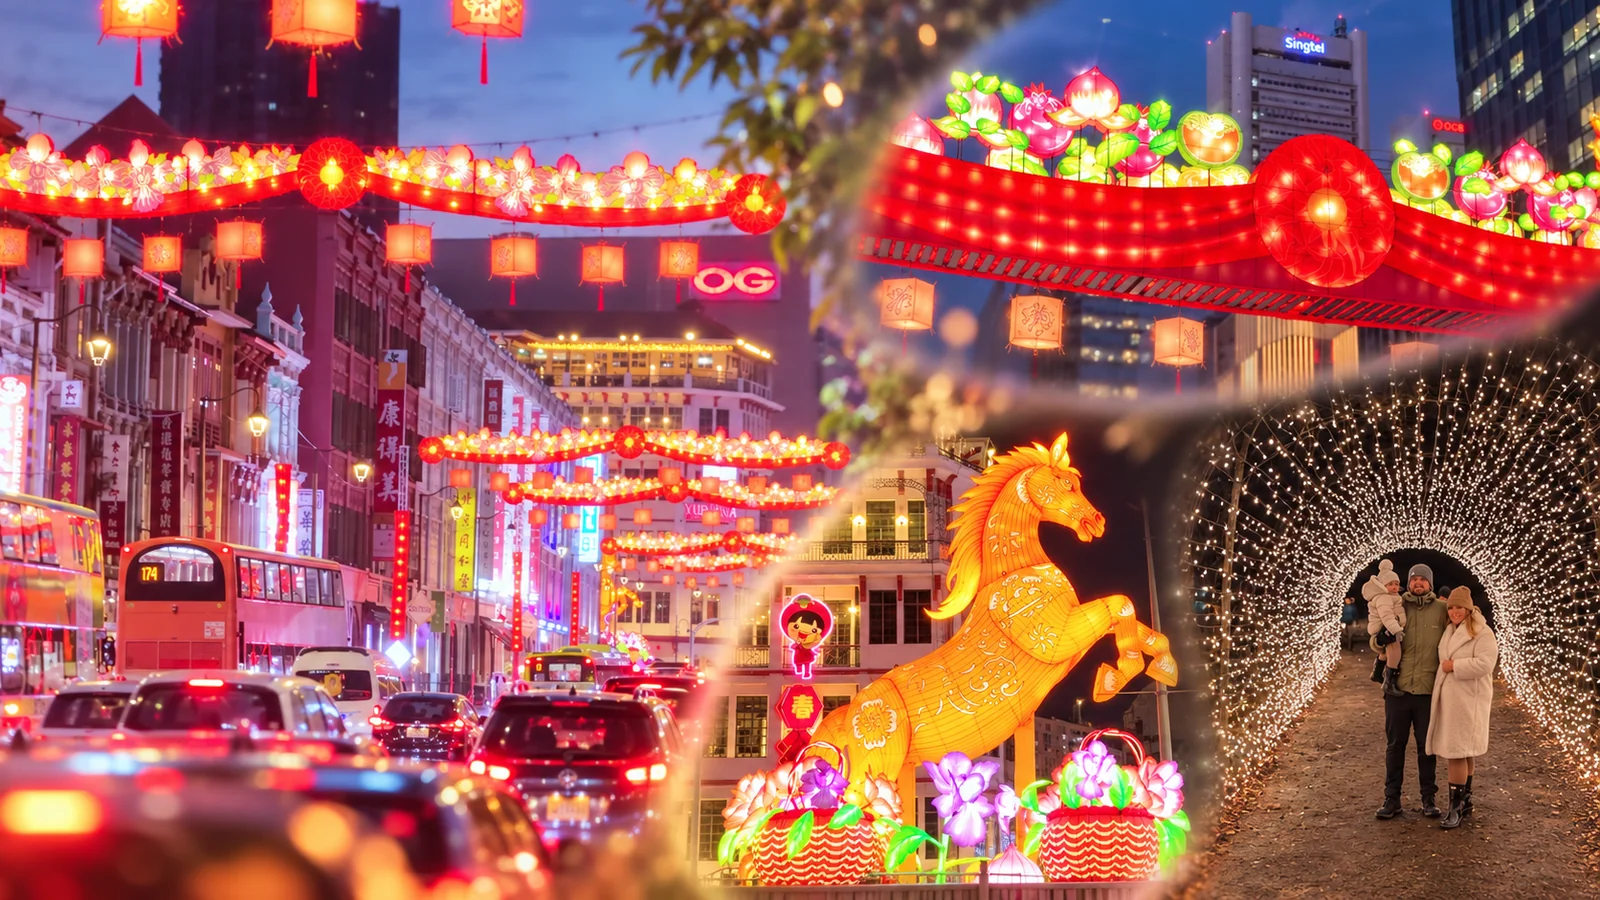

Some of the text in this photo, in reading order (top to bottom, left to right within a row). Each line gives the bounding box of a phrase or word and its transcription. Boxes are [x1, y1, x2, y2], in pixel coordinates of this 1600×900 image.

[1285, 37, 1325, 54] Singtel
[693, 266, 775, 295] OG
[377, 399, 401, 502] 康得美
[141, 566, 158, 581] 174
[791, 694, 814, 719] 春
